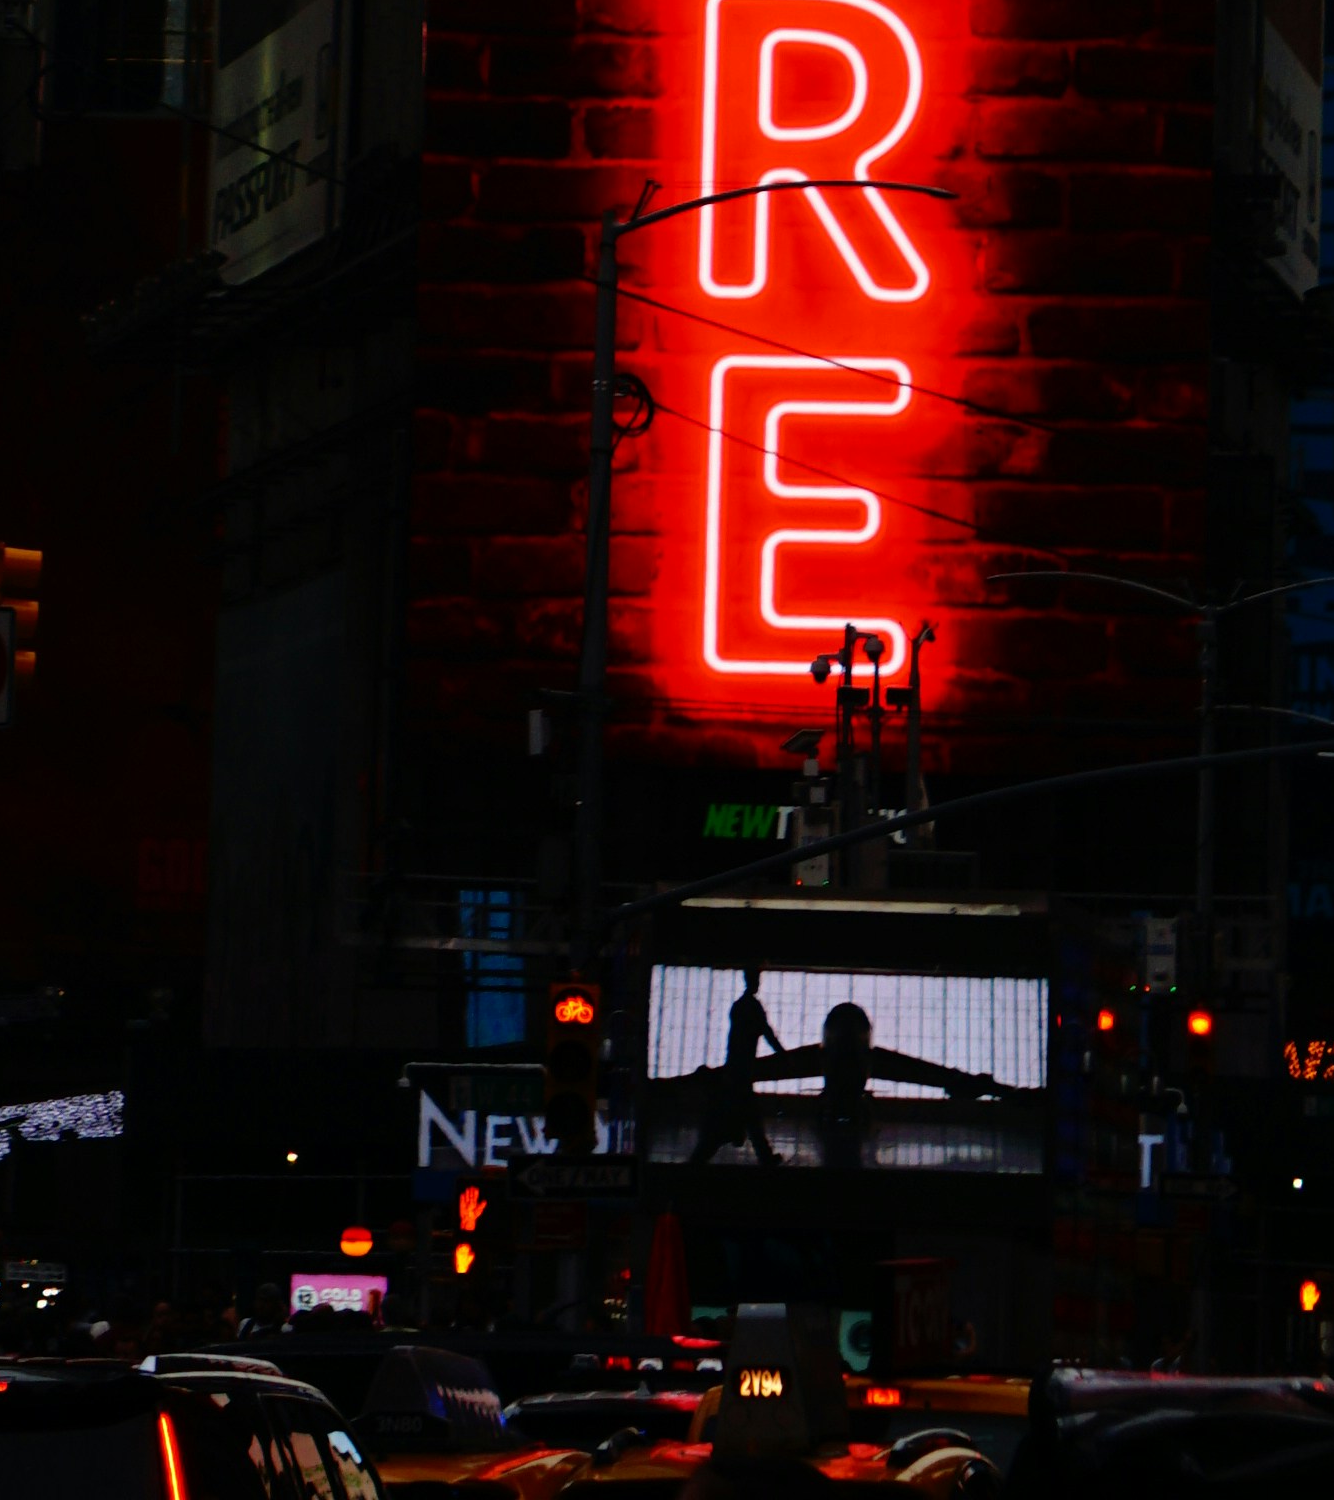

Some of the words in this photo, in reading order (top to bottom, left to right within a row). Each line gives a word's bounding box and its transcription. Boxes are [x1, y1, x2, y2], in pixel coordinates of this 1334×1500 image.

[477, 1083, 496, 1102] W
[506, 1083, 533, 1103] 44
[739, 1368, 784, 1398] 2Y94
